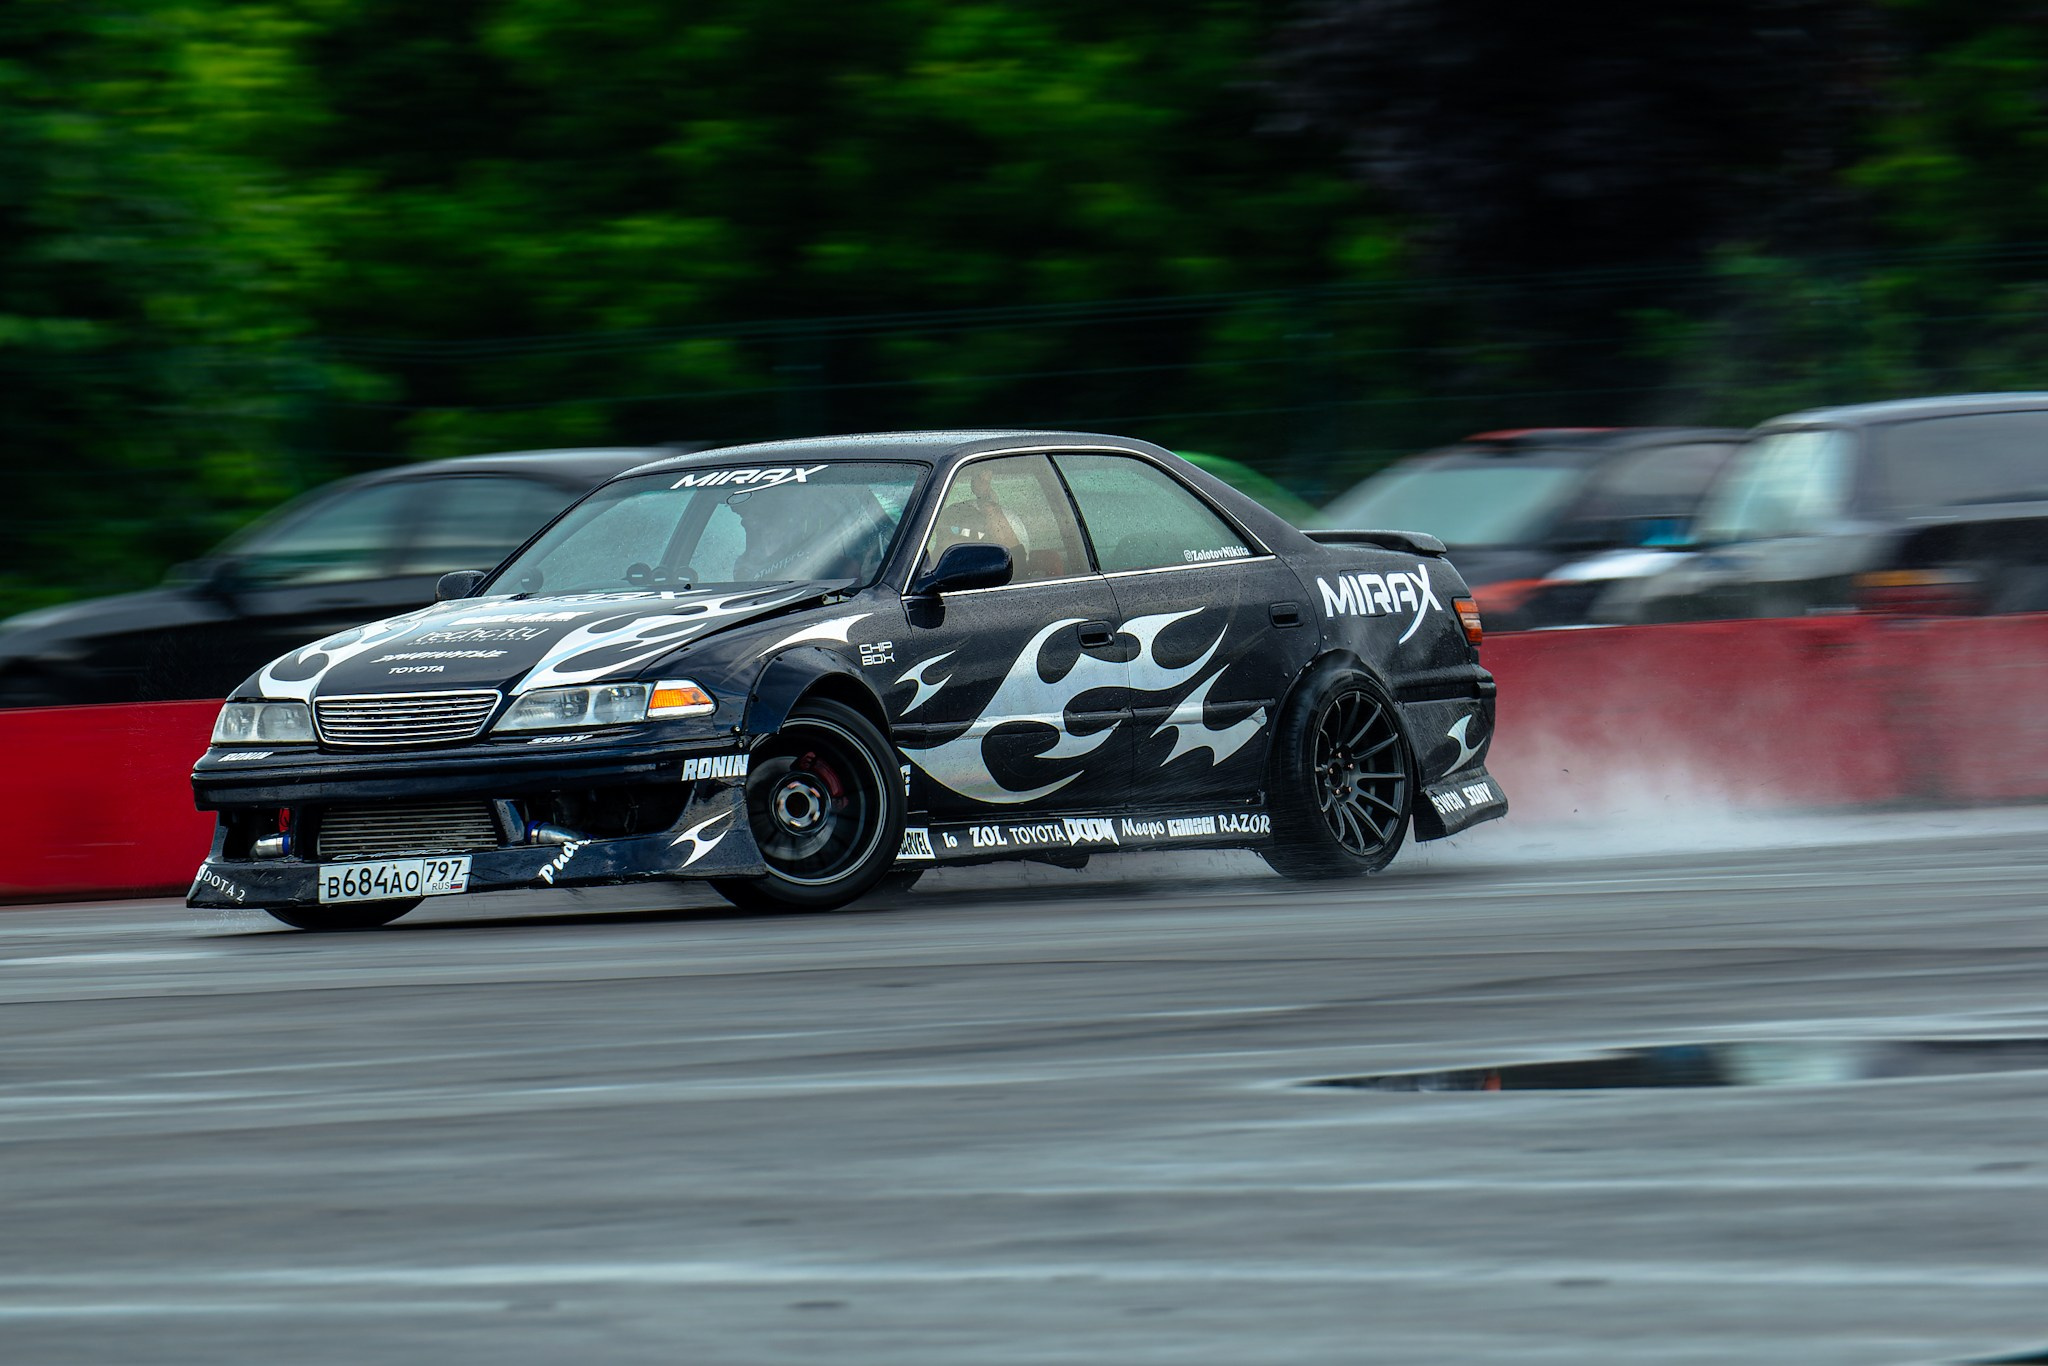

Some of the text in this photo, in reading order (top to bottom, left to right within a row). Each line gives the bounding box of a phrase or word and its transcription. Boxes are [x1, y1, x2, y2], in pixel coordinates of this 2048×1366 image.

[670, 464, 829, 495] MIRAX
[1183, 545, 1250, 562] @ZolotovNikita
[1316, 564, 1443, 645] MIRAX
[859, 641, 893, 655] CHIP
[861, 652, 896, 666] BOX
[388, 665, 445, 675] TOYOTA
[527, 734, 593, 745] SONY
[217, 751, 274, 762] RONIN
[681, 754, 750, 781] RONIN
[1462, 782, 1493, 806] SONY
[969, 825, 1007, 847] ZOL
[1009, 824, 1067, 845] TOYOTA
[1062, 818, 1120, 847] DOOM
[1121, 818, 1165, 839] Meepo
[1218, 814, 1271, 834] RAZOR
[426, 860, 463, 883] 797
[202, 870, 246, 902] DOTA 2
[431, 881, 450, 890] RUS
